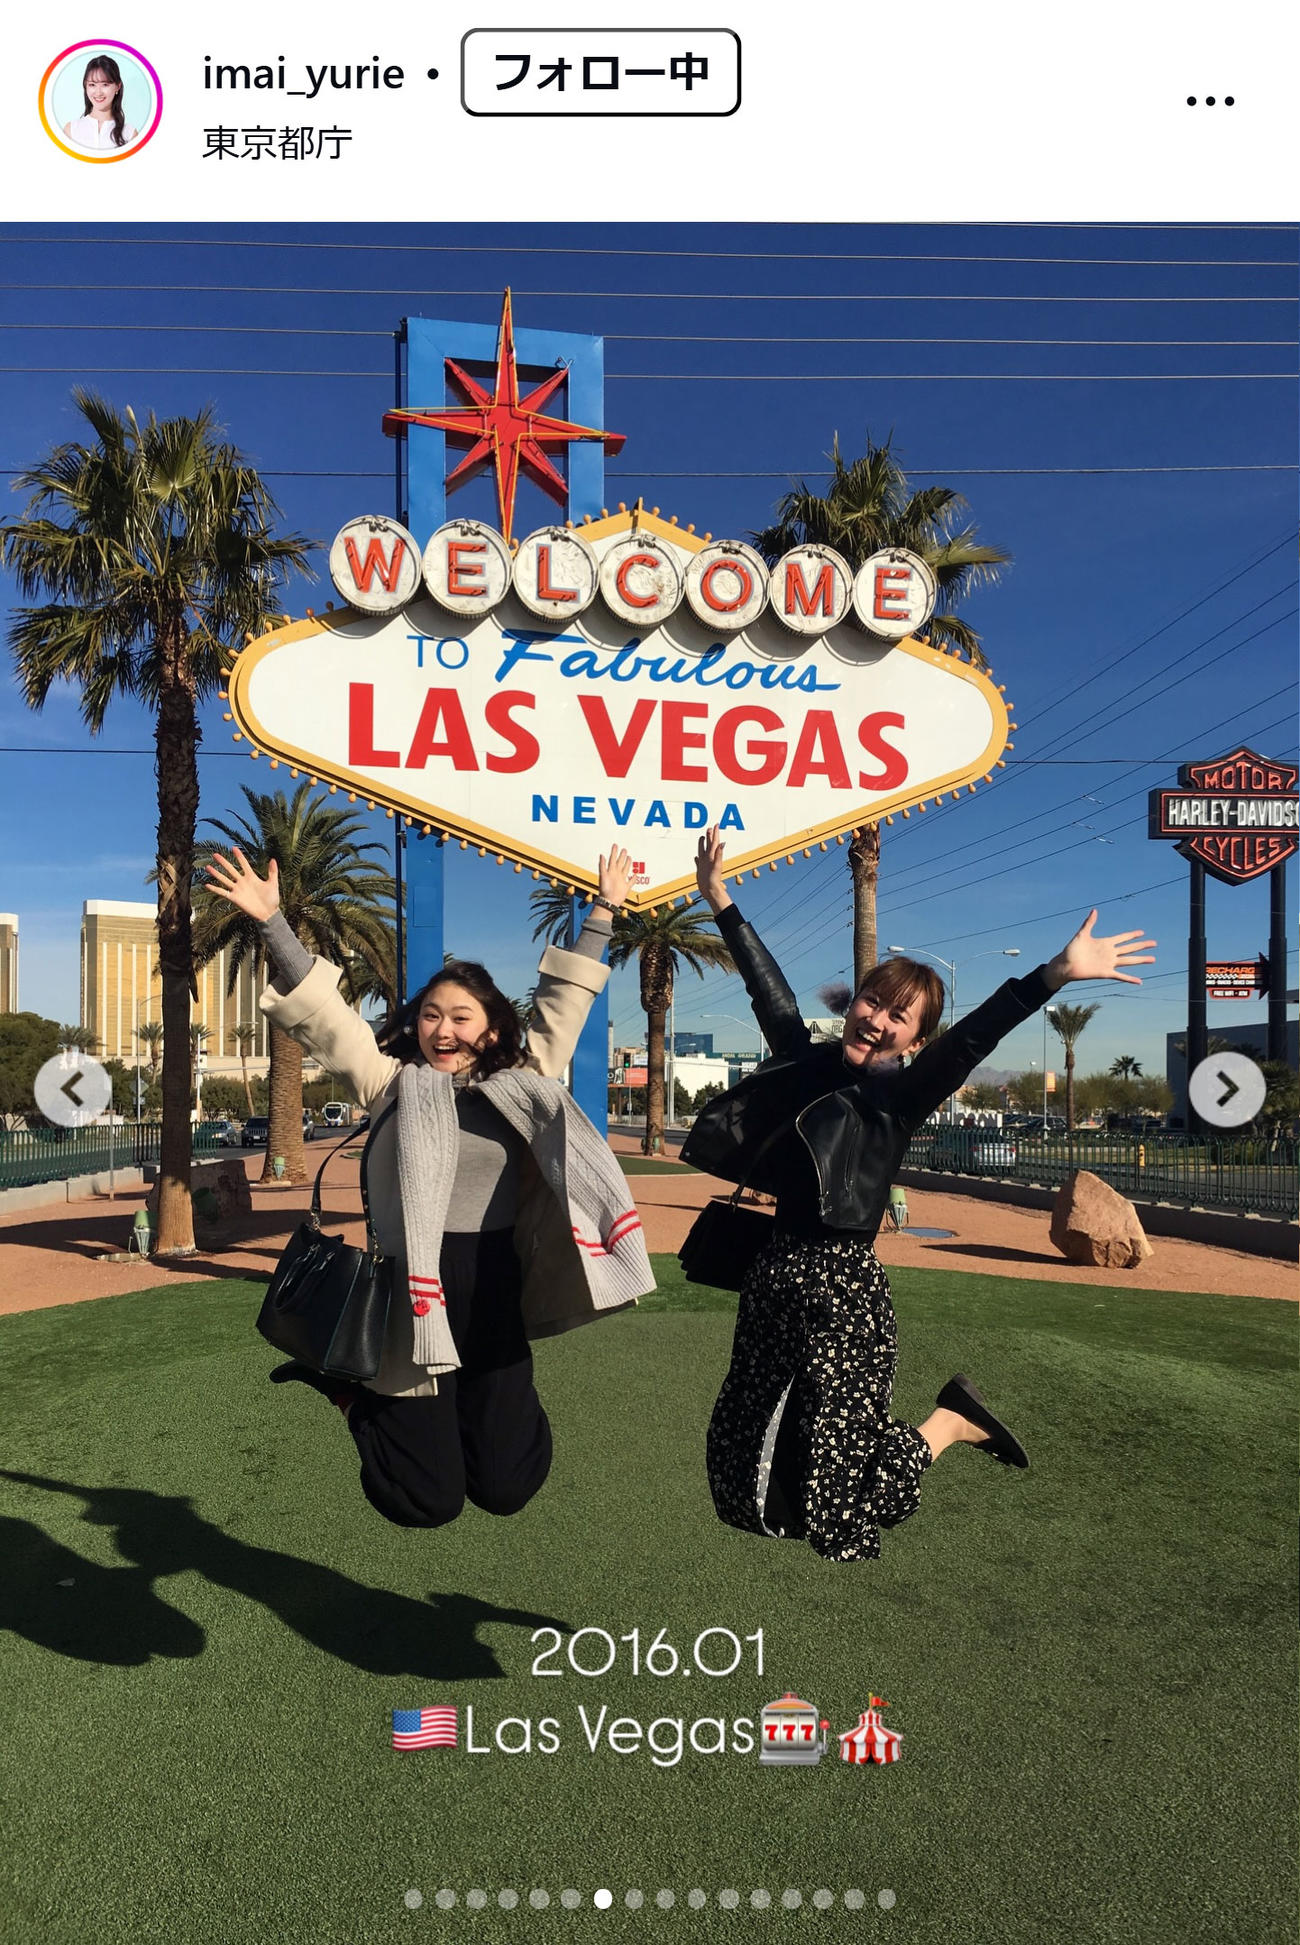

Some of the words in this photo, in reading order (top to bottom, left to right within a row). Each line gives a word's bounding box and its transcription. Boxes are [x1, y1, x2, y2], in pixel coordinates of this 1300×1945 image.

[343, 536, 912, 620] WELCOME
[407, 634, 470, 670] TO
[494, 628, 841, 693] Fabulous
[348, 682, 541, 774] LAS
[577, 694, 910, 791] VEGAS
[1204, 761, 1283, 790] MOTOR
[532, 794, 745, 831] NEVADA
[1203, 836, 1281, 870] CYCLES
